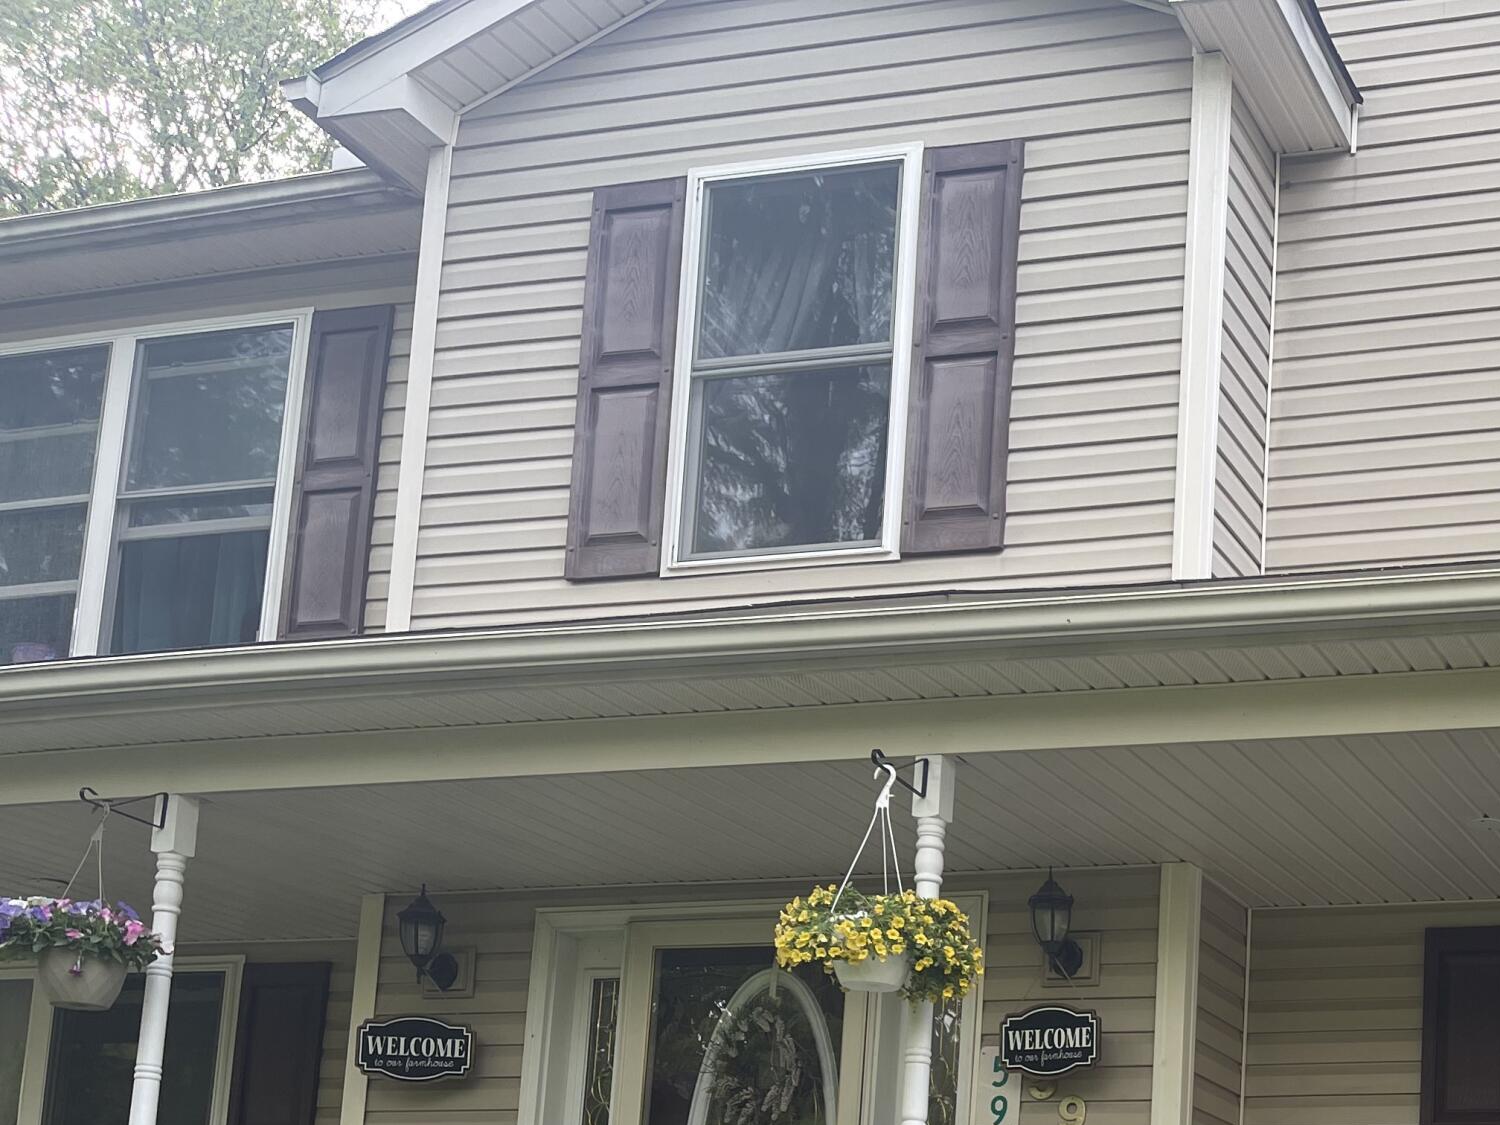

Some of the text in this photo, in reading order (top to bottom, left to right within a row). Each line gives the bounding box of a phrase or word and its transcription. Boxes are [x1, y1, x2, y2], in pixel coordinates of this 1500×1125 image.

[367, 1035, 465, 1058] WELCOME
[1008, 1026, 1091, 1050] WELCOME
[405, 1057, 455, 1073] farmhouse
[1040, 1049, 1083, 1066] farmhouse
